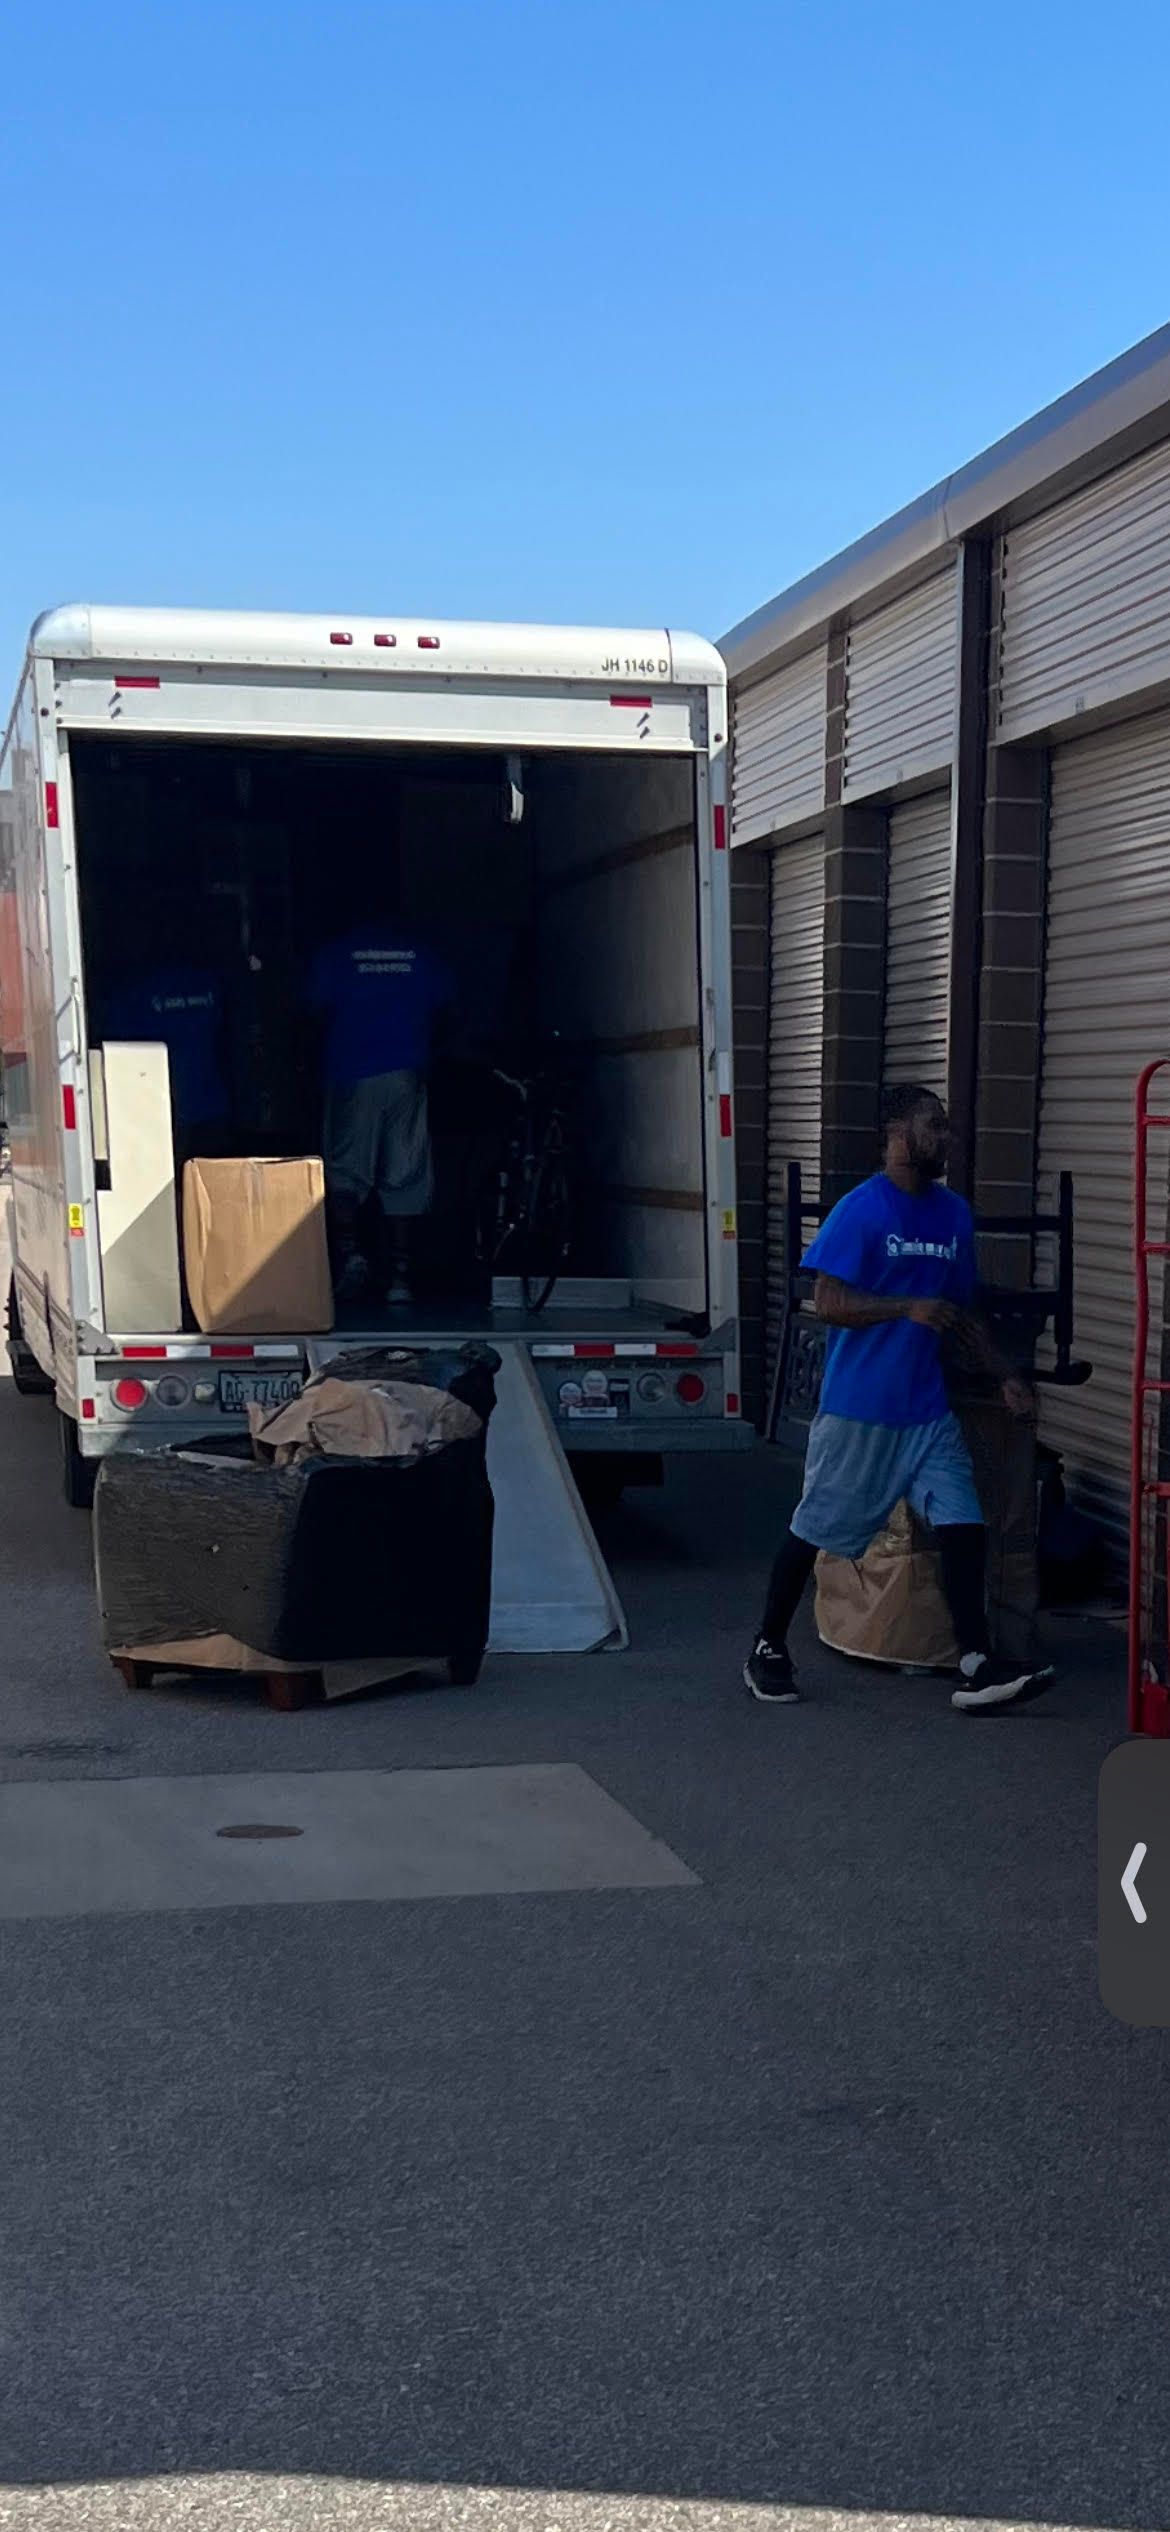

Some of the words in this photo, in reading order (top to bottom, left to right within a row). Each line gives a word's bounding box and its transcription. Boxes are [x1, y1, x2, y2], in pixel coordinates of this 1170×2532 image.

[601, 658, 620, 672] JH
[624, 658, 655, 673] 1146
[658, 659, 668, 673] D
